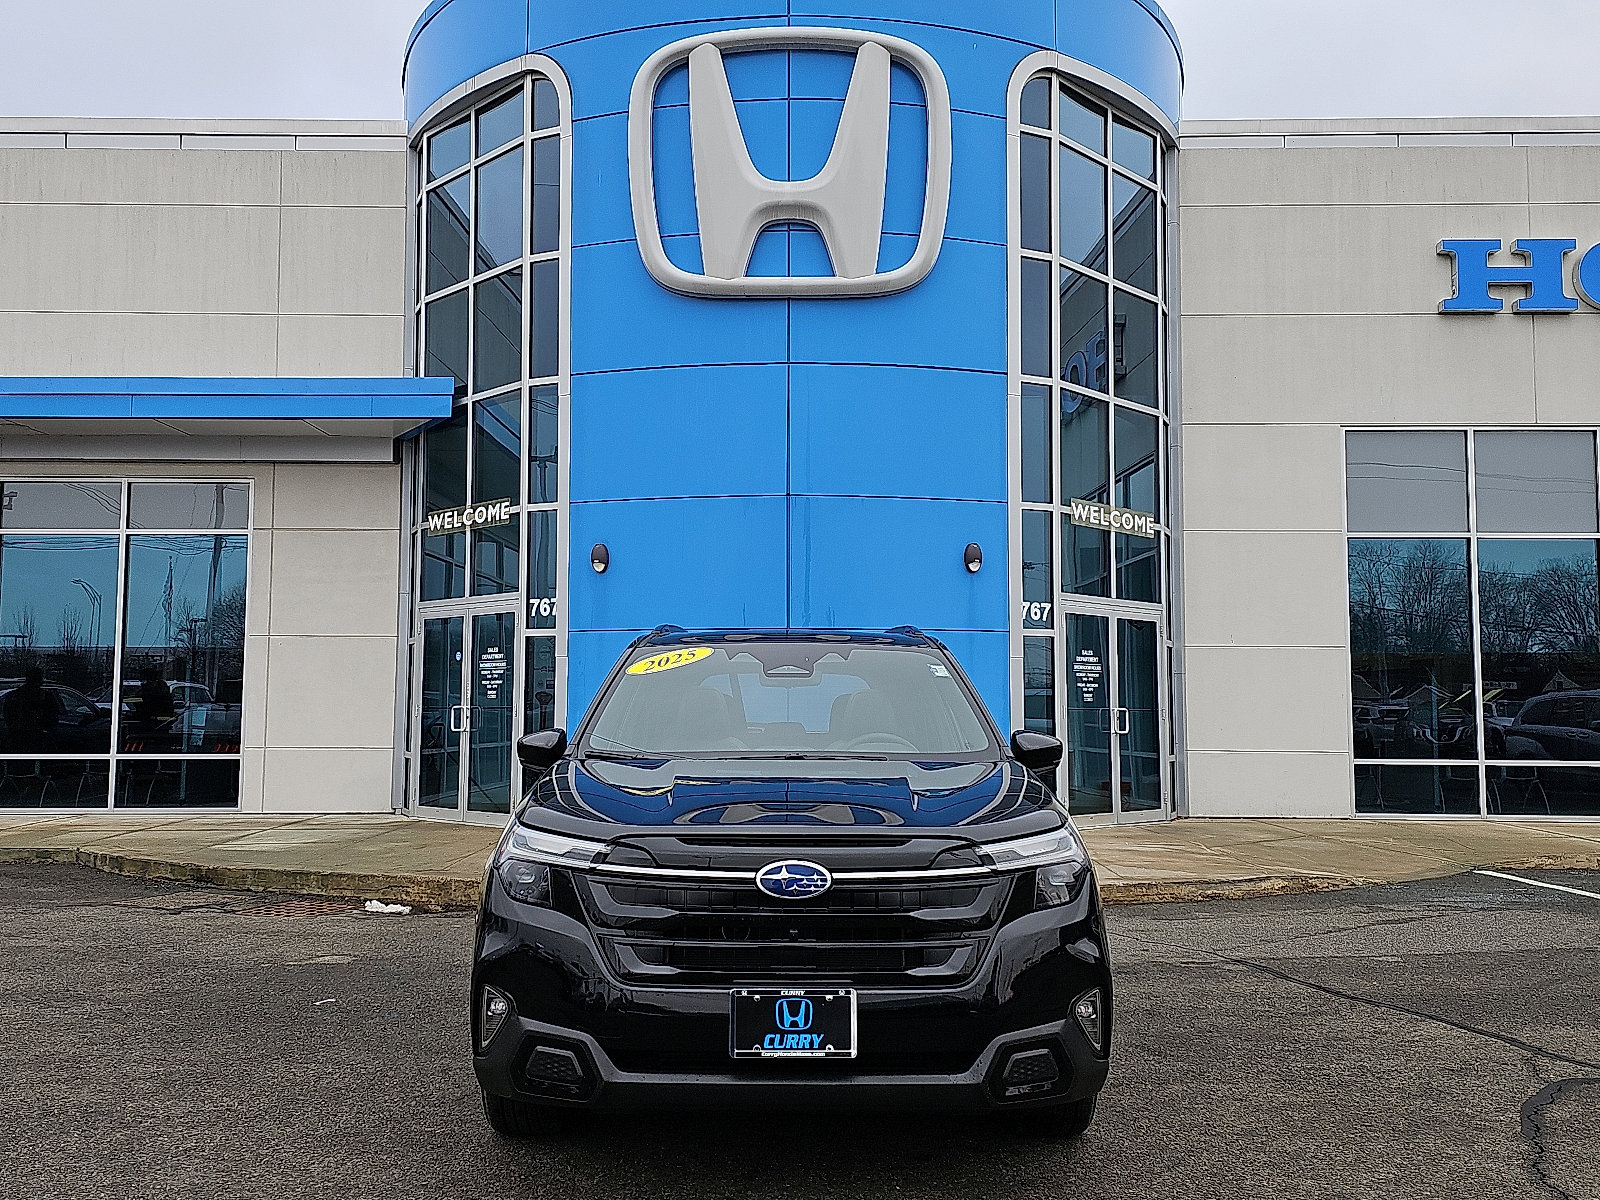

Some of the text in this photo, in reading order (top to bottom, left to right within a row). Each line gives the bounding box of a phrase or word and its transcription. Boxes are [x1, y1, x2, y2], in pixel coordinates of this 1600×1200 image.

[428, 502, 510, 531] WELCOME
[1071, 502, 1154, 534] WELCOME
[530, 598, 556, 617] 767
[1022, 602, 1051, 621] 767
[643, 650, 697, 672] 2025
[763, 1033, 825, 1049] CURRY
